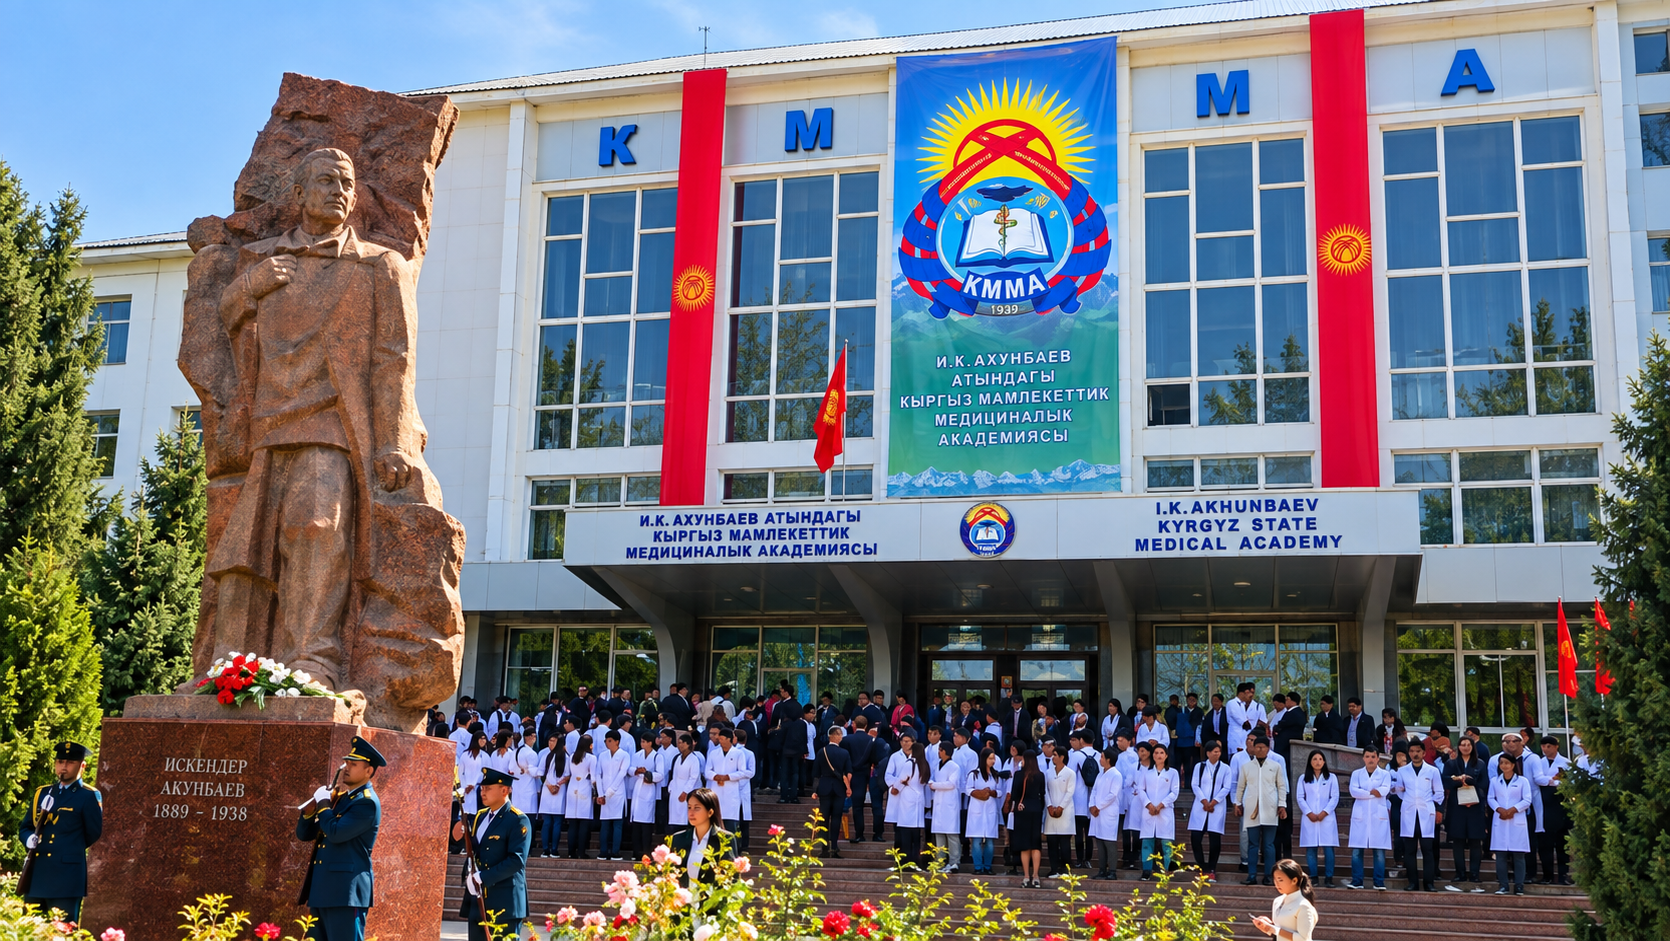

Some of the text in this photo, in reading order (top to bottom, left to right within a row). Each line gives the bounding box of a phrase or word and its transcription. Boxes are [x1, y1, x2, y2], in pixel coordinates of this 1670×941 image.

[598, 48, 1496, 167] К М М А
[963, 274, 1046, 299] КММА
[991, 304, 1018, 315] 1939
[951, 370, 1055, 387] АТЫНДАГЫ
[900, 387, 1109, 409] КЫРГЫЗ МАМЛЕКЕТТИК
[935, 408, 1073, 428] МЕДИЦИНАЛЫК
[938, 429, 1068, 447] АКАДЕМИЯСЫ
[764, 510, 861, 526] АТЫНДАГЫ
[1158, 517, 1317, 533] KYRGYZ STATE
[653, 527, 850, 543] КЫРГЫЗ МАМЛЕКЕТТИК
[1135, 535, 1343, 551] MEDICAL ACADEMY
[626, 543, 878, 560] МЕДИЦИНАЛЫК АКАДЕМИЯСЫ
[164, 757, 247, 775] ИСКЕНДЕР
[160, 781, 245, 797] АКУНБАЕВ
[153, 804, 189, 819] 1889
[211, 805, 248, 821] 1938
